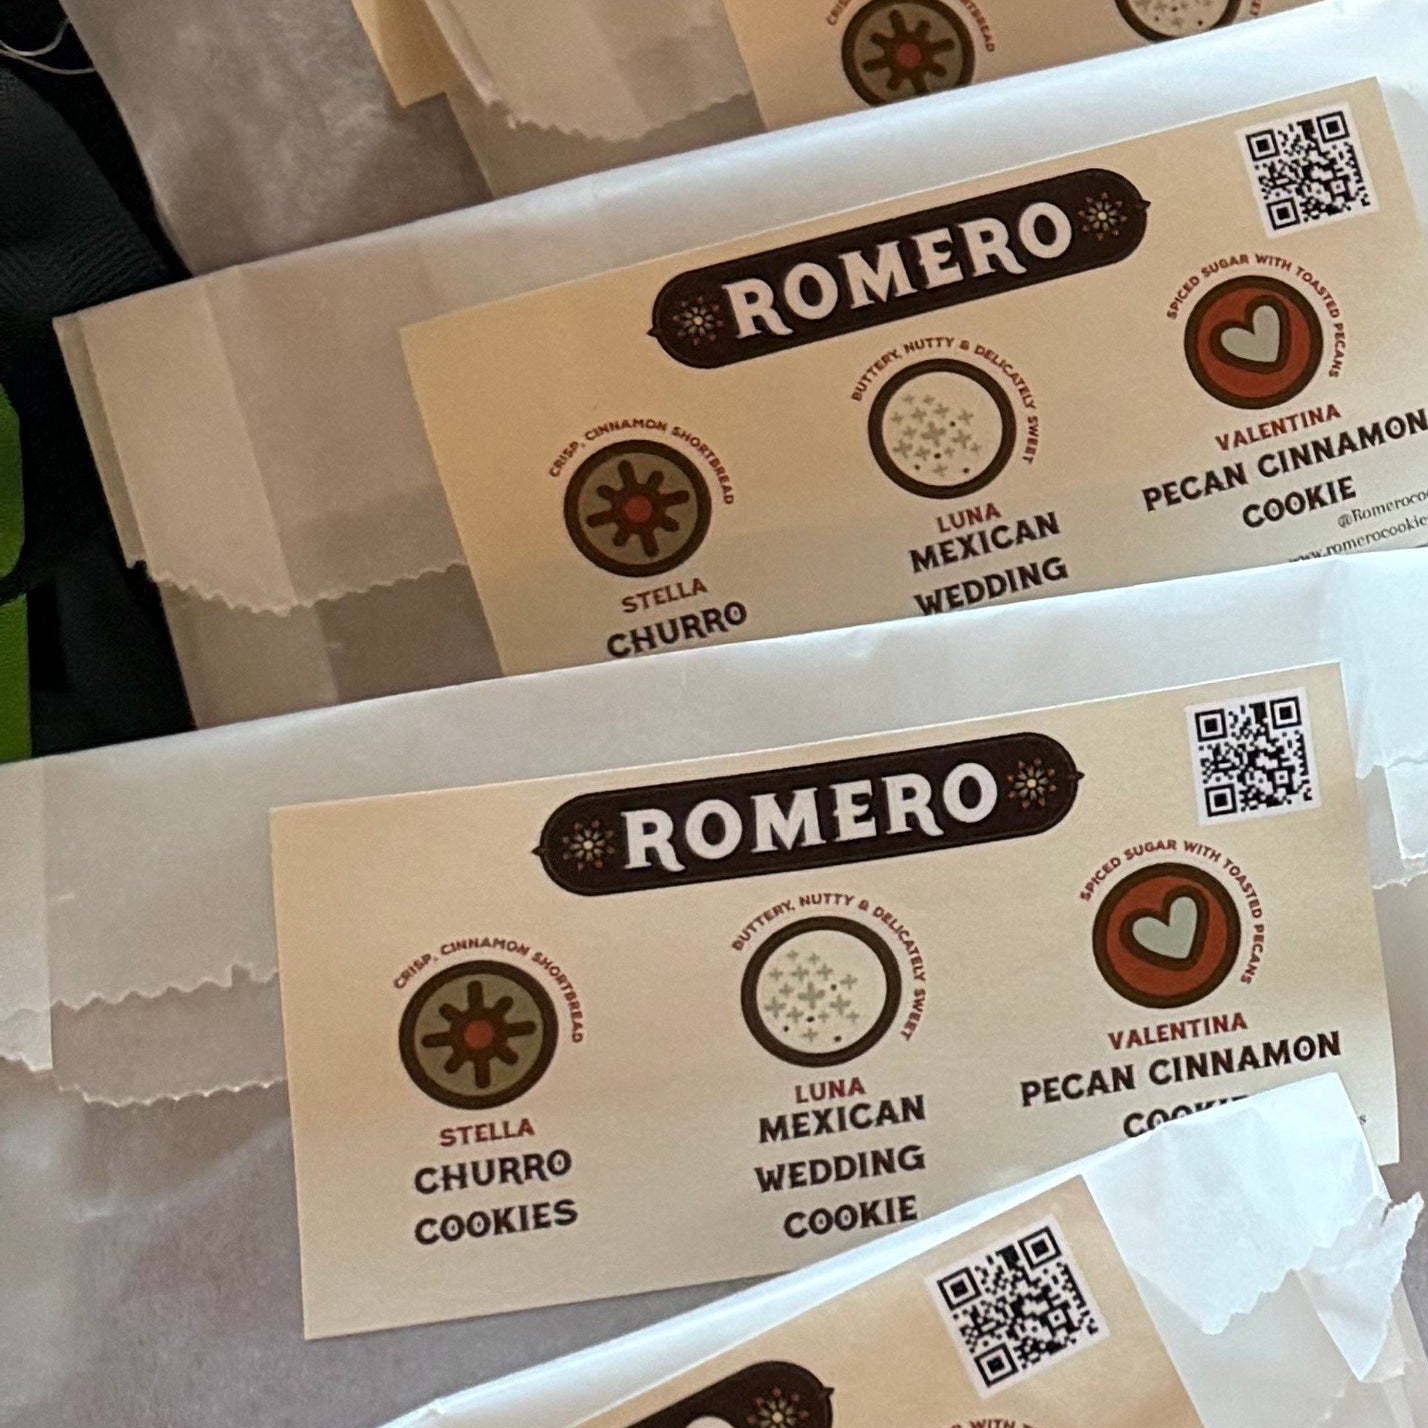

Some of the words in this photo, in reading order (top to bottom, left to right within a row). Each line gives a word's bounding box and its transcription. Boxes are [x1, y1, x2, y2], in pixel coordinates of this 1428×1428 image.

[720, 201, 1072, 339] ROMERO
[1166, 275, 1200, 320] SPICED
[1200, 253, 1250, 278] SUGAR
[1254, 253, 1293, 272] WITH
[1295, 265, 1340, 319] TOASTED
[1327, 322, 1346, 378] PECANS
[903, 336, 955, 354] NUTTY
[973, 343, 1036, 410] DELICATELY
[1022, 415, 1040, 465] SWEET
[1214, 403, 1343, 452] VALENTINA
[583, 417, 668, 442] CINNAMON
[670, 425, 735, 505] SHORTBREAD
[1141, 461, 1249, 513] PECAN
[936, 502, 1002, 534] LUNA
[1241, 475, 1358, 528] COOKIE
[909, 510, 1061, 574] MEXICAN
[620, 577, 709, 614] STELLA
[913, 555, 1069, 618] WEDDING
[605, 602, 748, 658] CHURRO
[622, 761, 998, 874] ROMERO
[1124, 839, 1177, 861] SUGAR
[1183, 839, 1221, 864] WITH
[1079, 856, 1122, 902] SPICED
[1222, 857, 1263, 920] TOASTED
[798, 892, 854, 907] NUTTY
[872, 905, 927, 982] DELICATELY
[901, 988, 926, 1042] SWEET
[1239, 923, 1265, 985] PECANS
[439, 937, 530, 957] CINNAMON
[531, 952, 583, 1043] SHORTBREAD
[1108, 1012, 1248, 1051] VALENTINA
[795, 1076, 866, 1105] LUNA
[1020, 1064, 1136, 1108] PECAN
[1148, 1029, 1341, 1086] CINNAMON
[438, 1117, 536, 1148] STELLA
[759, 1093, 926, 1145] MEXICAN
[413, 1149, 572, 1193] CHURRO
[753, 1143, 926, 1194] WEDDING
[413, 1199, 578, 1244] COOKIES
[783, 1194, 918, 1240] COOKIE
